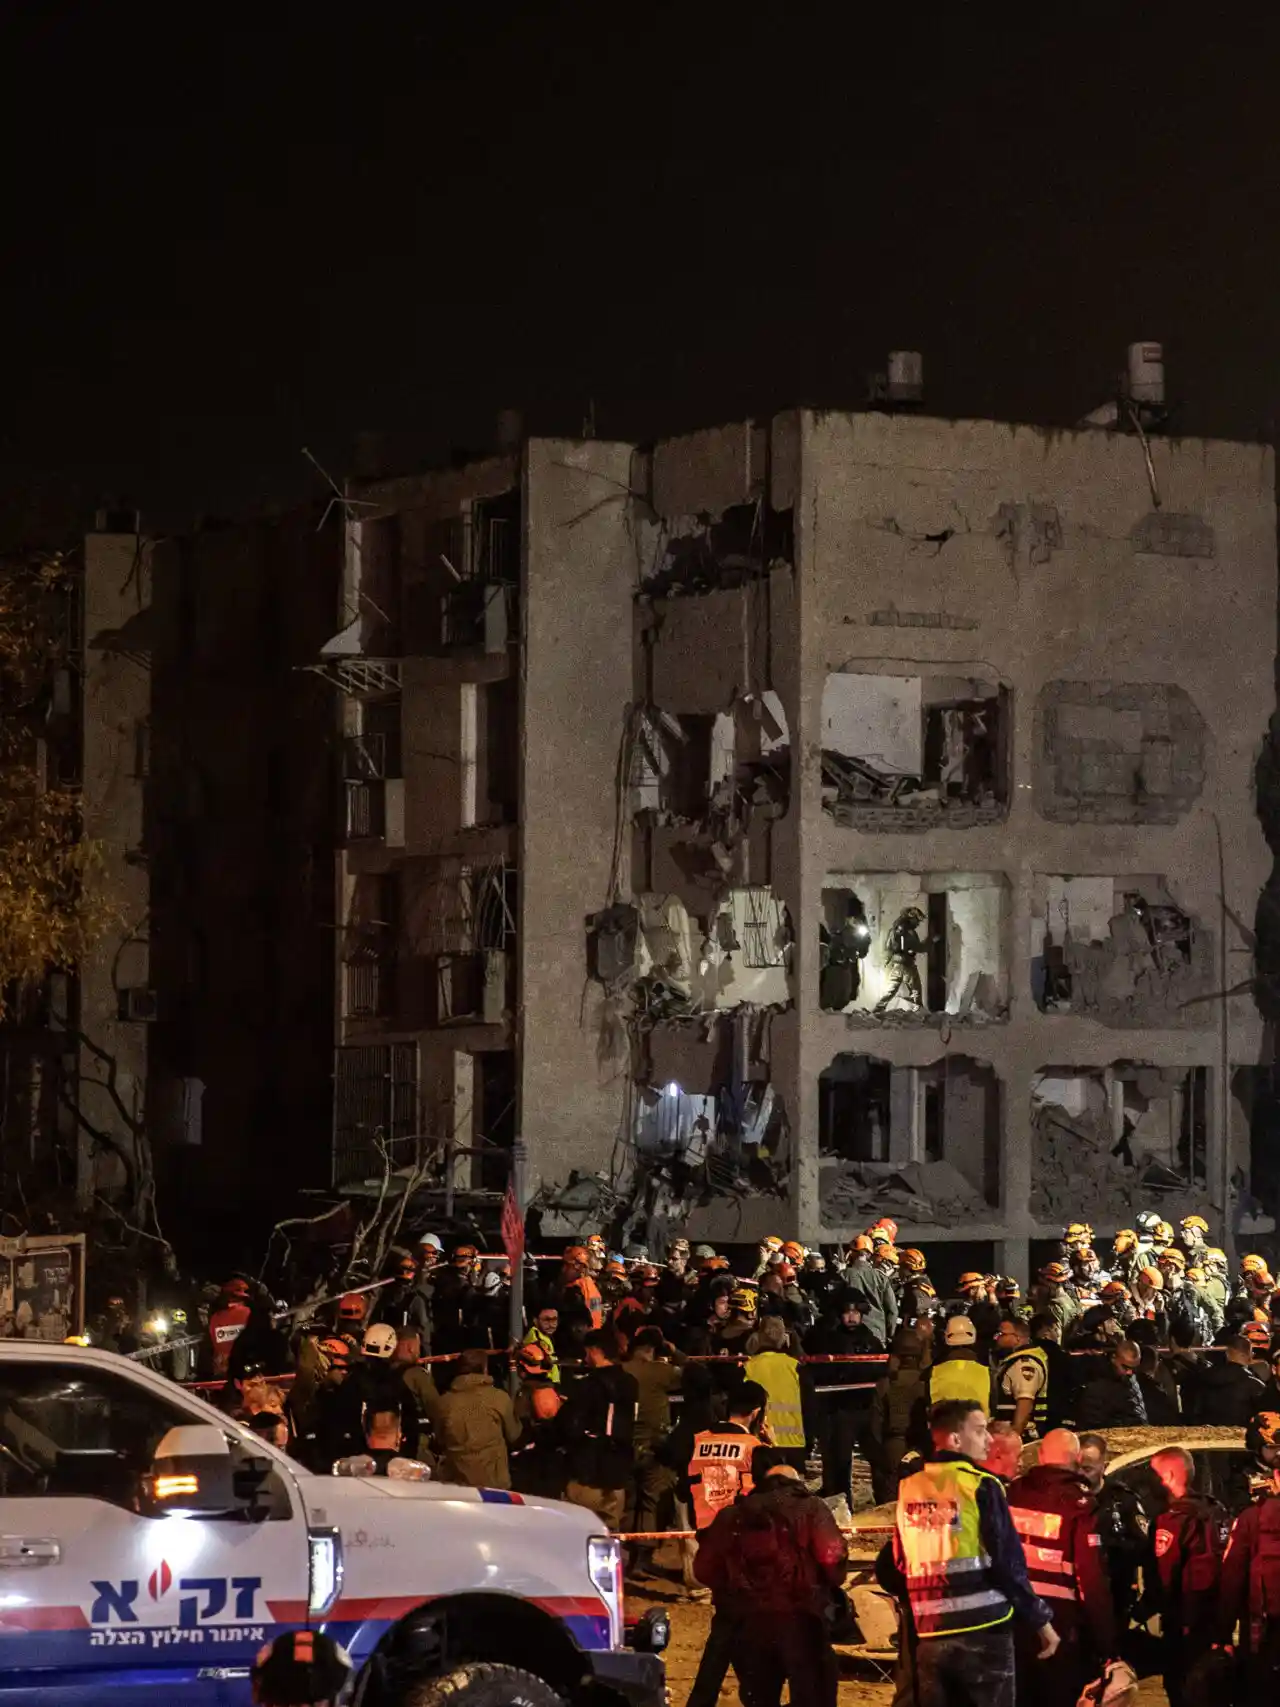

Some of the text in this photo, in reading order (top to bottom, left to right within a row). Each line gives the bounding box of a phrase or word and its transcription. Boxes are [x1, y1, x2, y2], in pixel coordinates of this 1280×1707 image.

[699, 1443, 741, 1458] חובש
[90, 1626, 265, 1648] איתור חילוץ הצלה
